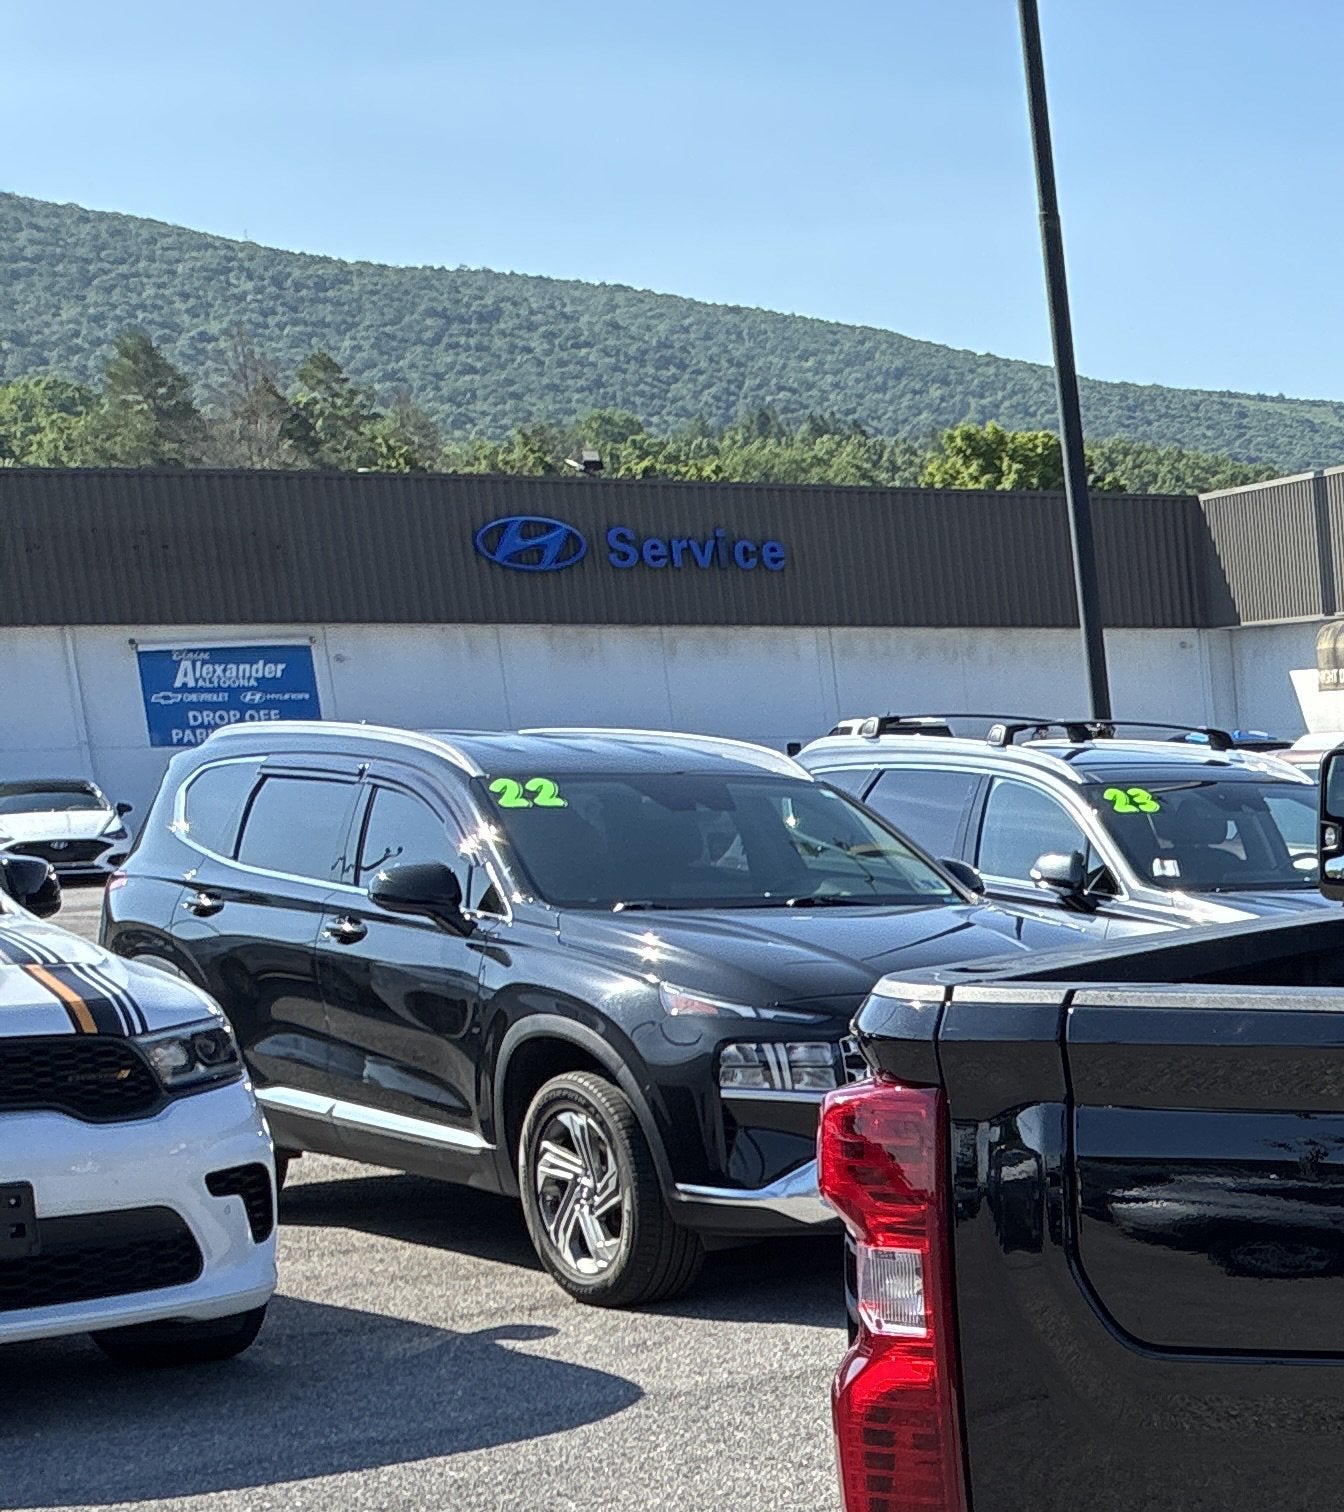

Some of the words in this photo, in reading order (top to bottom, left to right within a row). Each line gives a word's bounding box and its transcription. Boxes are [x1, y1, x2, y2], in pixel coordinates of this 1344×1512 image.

[606, 526, 786, 570] Service
[173, 659, 286, 689] Alexander
[187, 710, 241, 727] DROP
[489, 777, 568, 808] 22
[1104, 788, 1161, 812] 23
